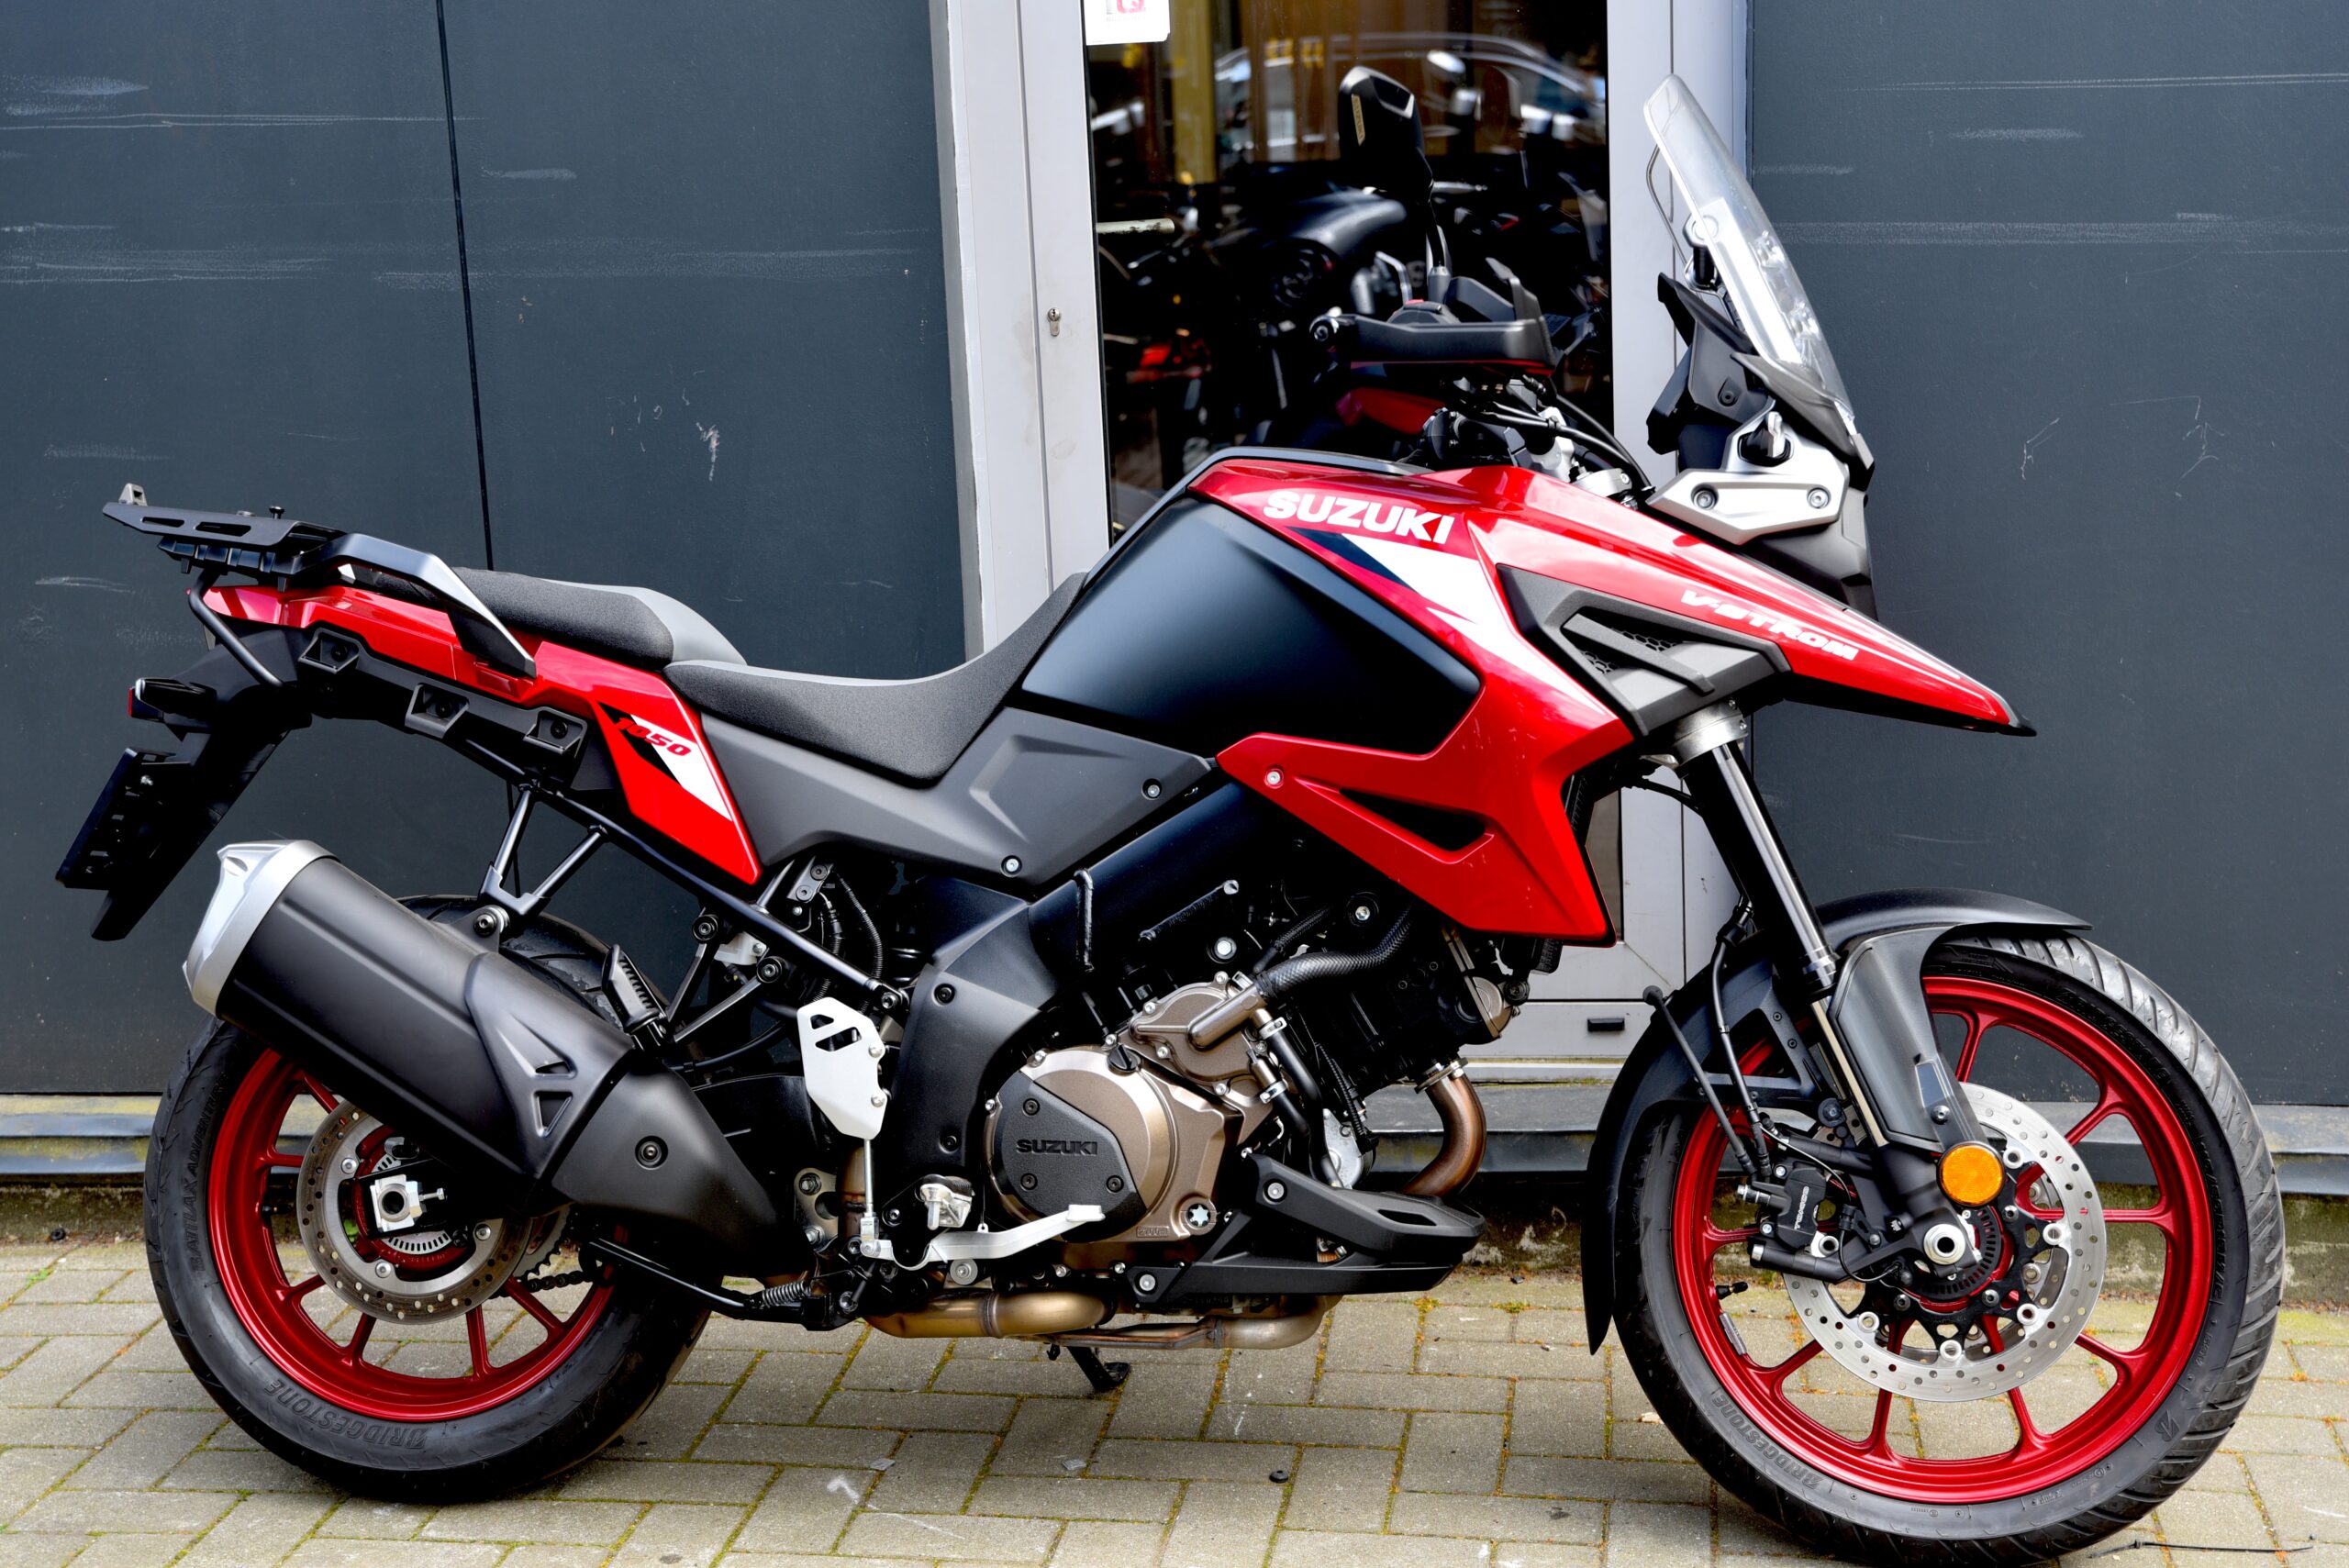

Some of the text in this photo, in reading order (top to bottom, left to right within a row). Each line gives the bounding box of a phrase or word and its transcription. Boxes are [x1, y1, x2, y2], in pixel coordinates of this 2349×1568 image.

[1264, 491, 1455, 545] SUZUKI
[1681, 590, 1859, 661] V-STROM
[613, 717, 692, 757] 1050
[1016, 1140, 1098, 1156] SUZUKI
[184, 1177, 206, 1273] BATTLAX
[263, 1378, 430, 1450] BRIDGESTONE
[1711, 1395, 1824, 1490] BRIDGESTONE
